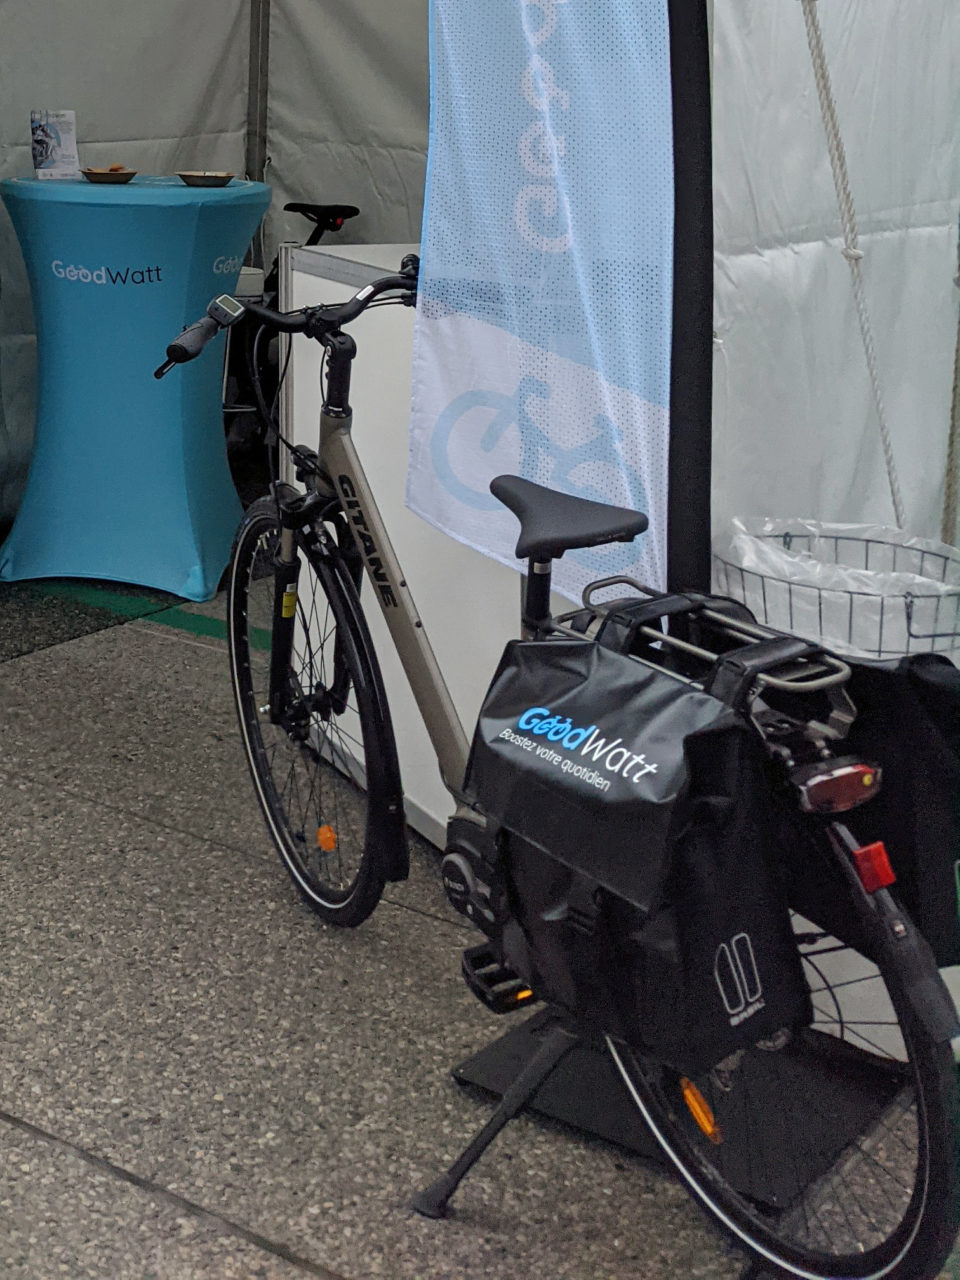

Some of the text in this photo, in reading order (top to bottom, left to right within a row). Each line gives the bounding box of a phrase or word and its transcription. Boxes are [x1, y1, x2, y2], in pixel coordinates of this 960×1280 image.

[51, 259, 163, 286] GoodWatt
[338, 473, 398, 608] GITANE
[498, 728, 611, 793] Boostez votre quotidien
[517, 707, 658, 784] GoodWatt
